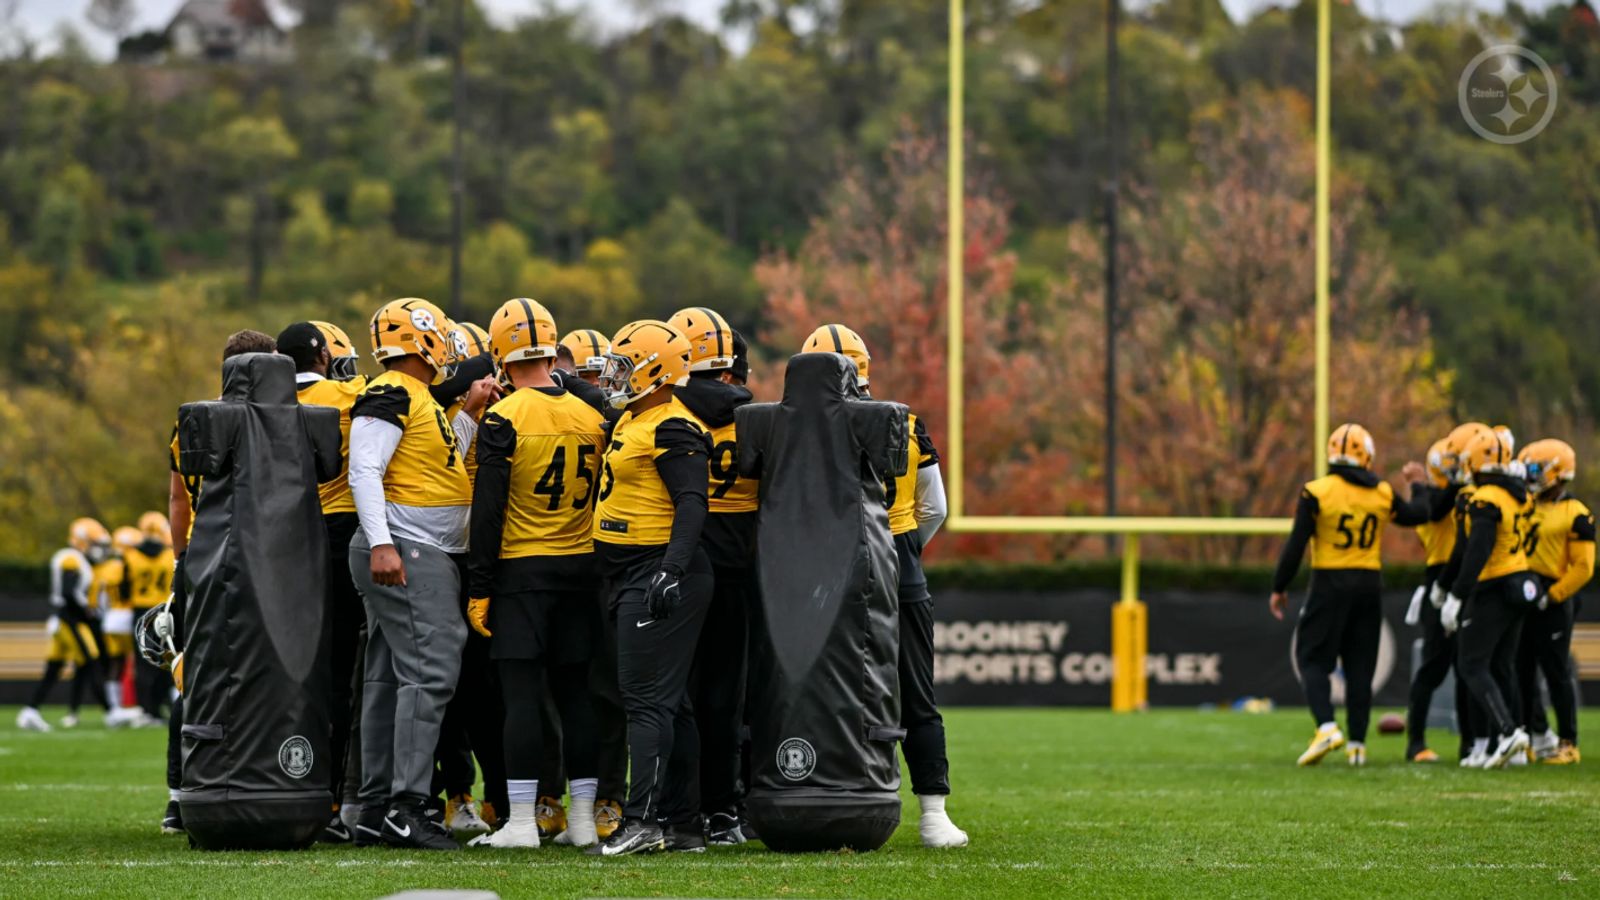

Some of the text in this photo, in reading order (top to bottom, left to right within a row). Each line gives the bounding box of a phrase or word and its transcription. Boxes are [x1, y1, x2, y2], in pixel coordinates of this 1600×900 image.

[533, 444, 596, 511] 45
[1333, 513, 1379, 550] 50
[1060, 653, 1222, 684] COPLEX
